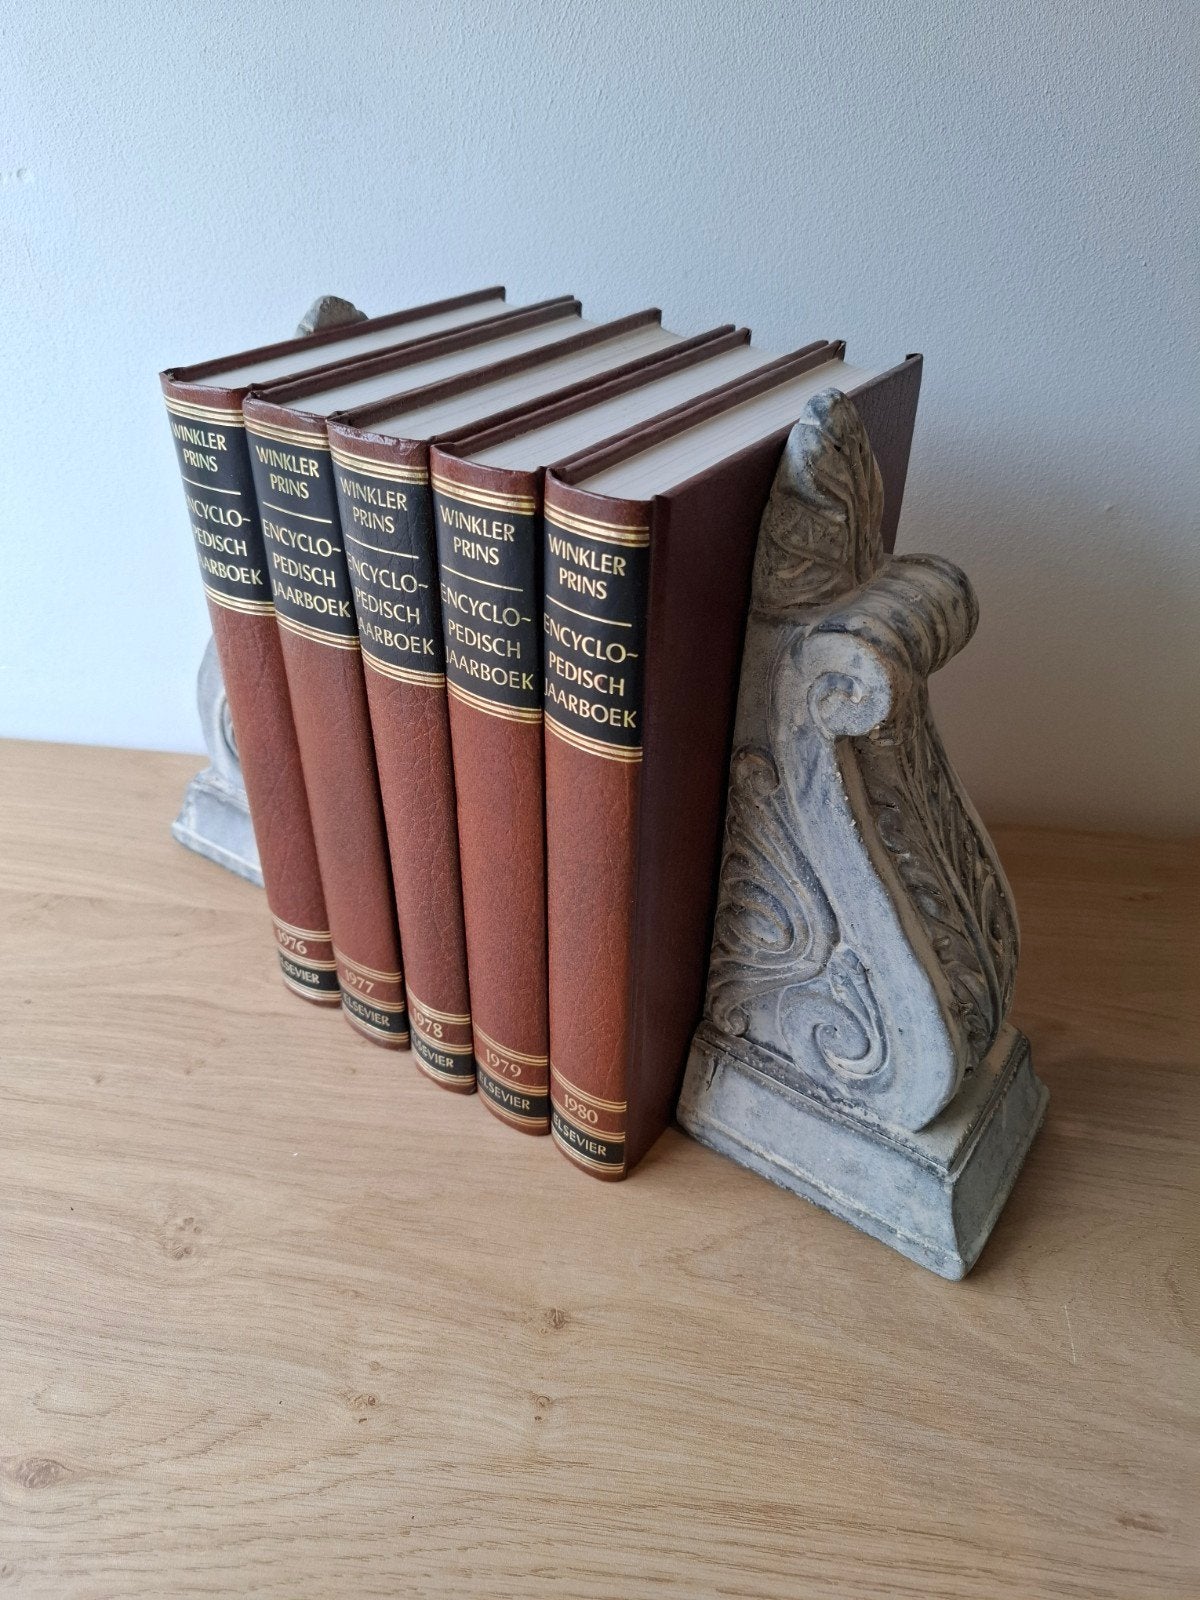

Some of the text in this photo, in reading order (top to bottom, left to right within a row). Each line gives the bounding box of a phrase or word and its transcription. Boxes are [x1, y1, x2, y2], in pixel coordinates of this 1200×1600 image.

[171, 421, 227, 450] WINKLER
[183, 448, 218, 472] PRINS
[256, 445, 319, 477] WINKLER
[269, 473, 309, 499] PRINS
[340, 476, 407, 511] WINKLER
[187, 494, 251, 527] NCYCLO-
[352, 506, 395, 534] PRINS
[440, 504, 515, 542] WINKLER
[263, 518, 341, 557] ENCYCLO-
[453, 536, 499, 565] PRINS
[548, 533, 626, 576] WINKLER
[199, 553, 263, 585] AARBOEK
[273, 552, 336, 588] PEDISCH
[559, 567, 607, 600] PRINS
[272, 579, 350, 618] JAARBOEK
[354, 586, 420, 625] PEDISCH
[440, 582, 531, 627] ENCYCLO-
[358, 616, 434, 655] AARBOEK
[448, 618, 521, 659] PEDISCH
[543, 614, 638, 663] ENCYCLO-
[446, 645, 533, 690] JAARBOEK
[549, 650, 625, 696] PEDISCH
[544, 678, 636, 728] JAARBOEK
[277, 929, 308, 955] 1976
[345, 968, 374, 994] 1977
[343, 993, 390, 1027] ELSEVIER
[413, 1007, 443, 1038] 1978
[486, 1049, 522, 1078] 1979
[479, 1071, 530, 1110] ELSEVIER
[564, 1094, 598, 1124] 1980
[553, 1111, 607, 1156] ELSEVIER
